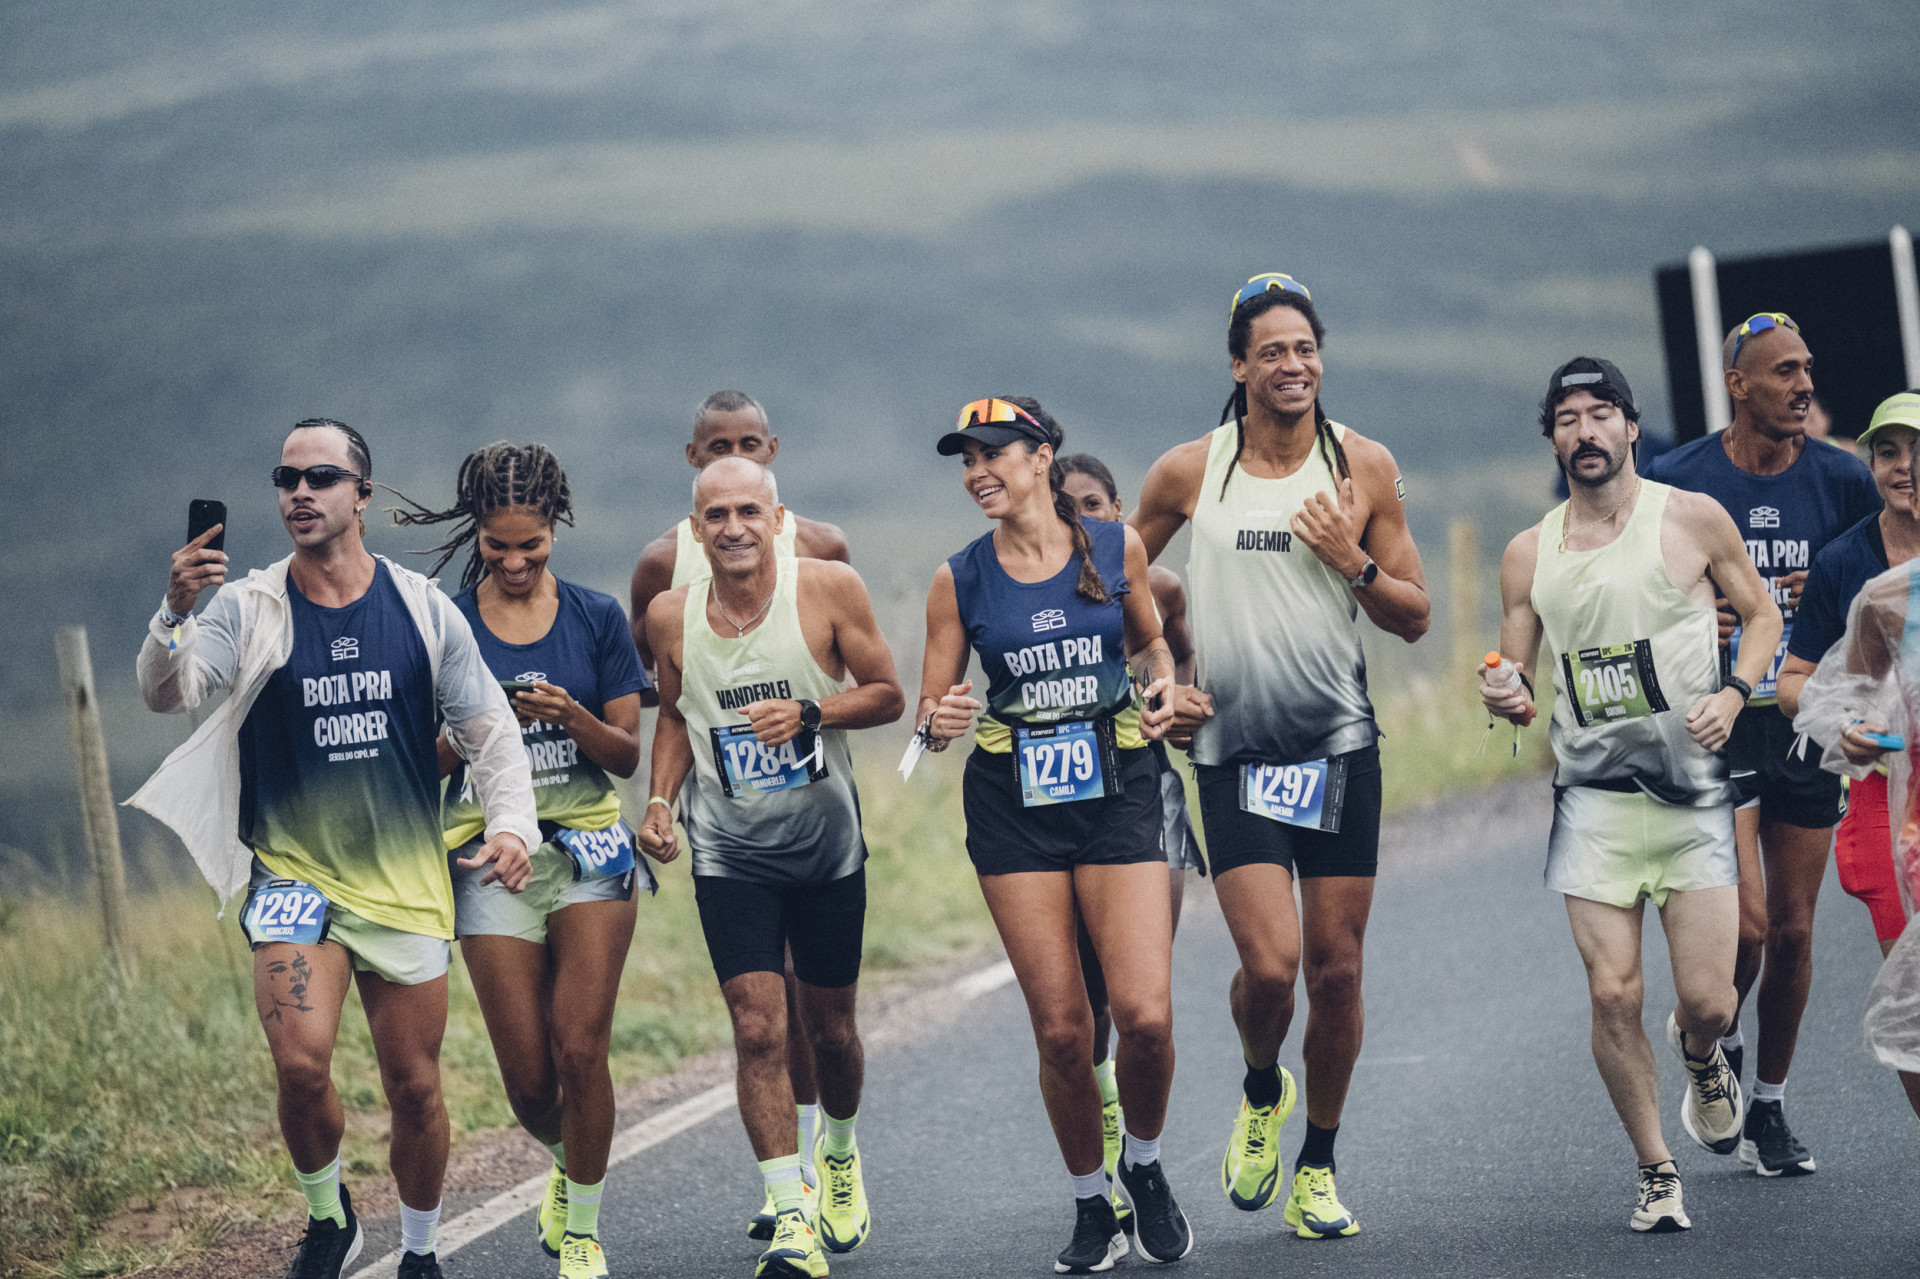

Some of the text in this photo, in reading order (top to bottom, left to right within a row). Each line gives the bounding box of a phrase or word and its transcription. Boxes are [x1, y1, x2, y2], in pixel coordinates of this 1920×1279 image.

[1236, 529, 1292, 552] ADEMIR
[1744, 539, 1809, 568] TA PRA
[1003, 634, 1103, 677] BOTA PRA
[302, 670, 393, 707] BOTA PRA
[716, 680, 793, 709] VANDERLEI
[1021, 675, 1099, 710] CORRER
[1580, 662, 1638, 706] 2105
[313, 710, 389, 748] CORRER
[524, 738, 578, 772] ORRER
[725, 740, 799, 781] 1284
[1022, 739, 1094, 788] 1279
[1049, 784, 1076, 797] CAMILA
[1254, 762, 1320, 808] 1297
[1270, 803, 1295, 818] ADEMIR
[569, 822, 631, 873] 1354
[250, 891, 322, 926] 1292
